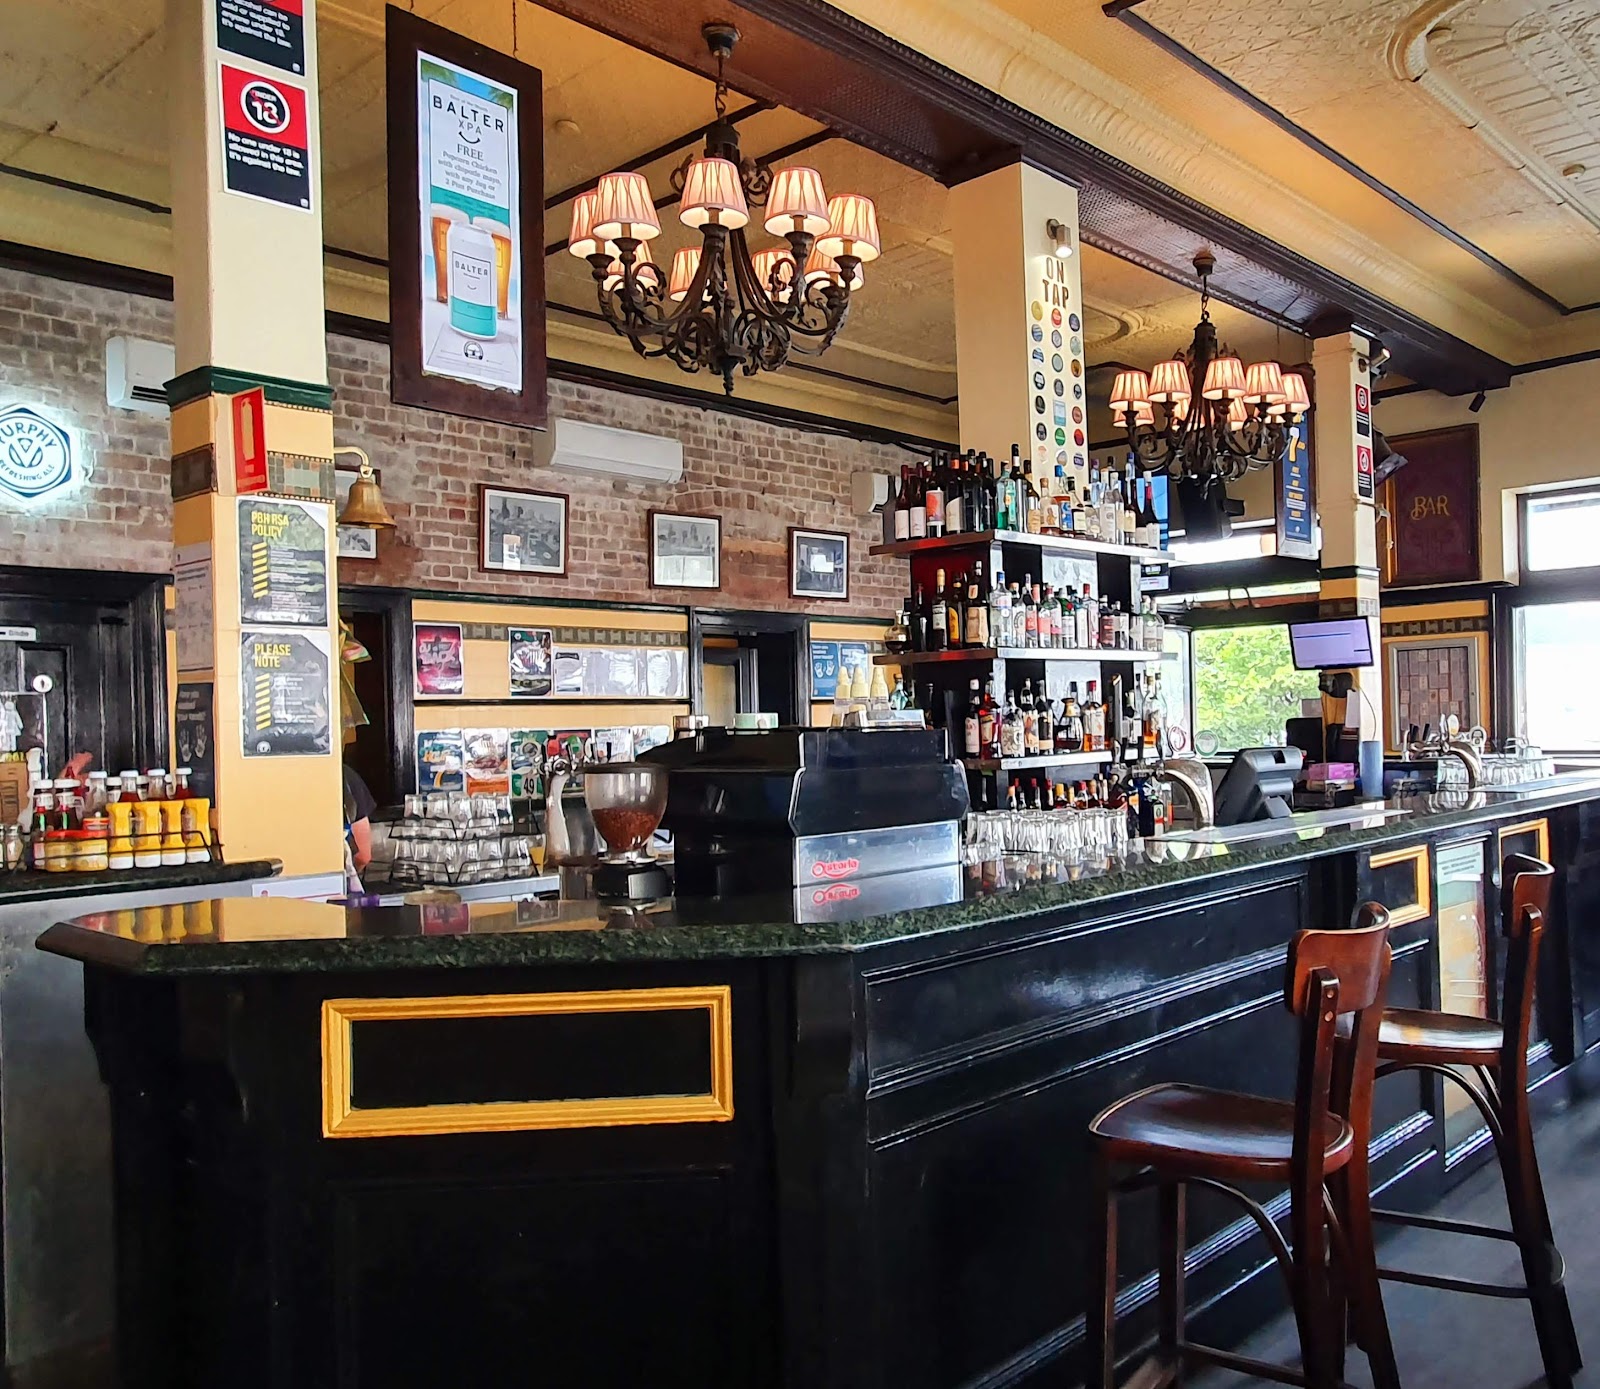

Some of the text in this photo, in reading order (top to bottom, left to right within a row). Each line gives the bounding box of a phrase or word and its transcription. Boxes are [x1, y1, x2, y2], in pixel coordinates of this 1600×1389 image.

[251, 101, 279, 124] 18
[433, 94, 504, 133] BALTER
[458, 119, 482, 135] XPA
[228, 131, 240, 143] No
[241, 137, 257, 148] one
[258, 141, 281, 154] under
[228, 142, 260, 157] allowed
[269, 152, 284, 163] this
[457, 143, 484, 162] FREE
[242, 155, 272, 170] against
[272, 162, 285, 173] the
[437, 159, 453, 168] with
[454, 164, 481, 178] chipotle
[443, 150, 498, 175] Popcorn Chicken
[445, 170, 461, 180] with
[461, 176, 474, 184] any
[445, 178, 450, 186] 2
[466, 185, 496, 200] Purchase
[455, 260, 489, 277] BALTER
[1046, 257, 1064, 284] ON
[1042, 279, 1069, 309] TAP
[1411, 494, 1450, 520] BAR
[251, 523, 283, 538] POLICY
[254, 643, 291, 656] PLEASE
[254, 655, 281, 668] NOTE
[523, 777, 535, 795] 49
